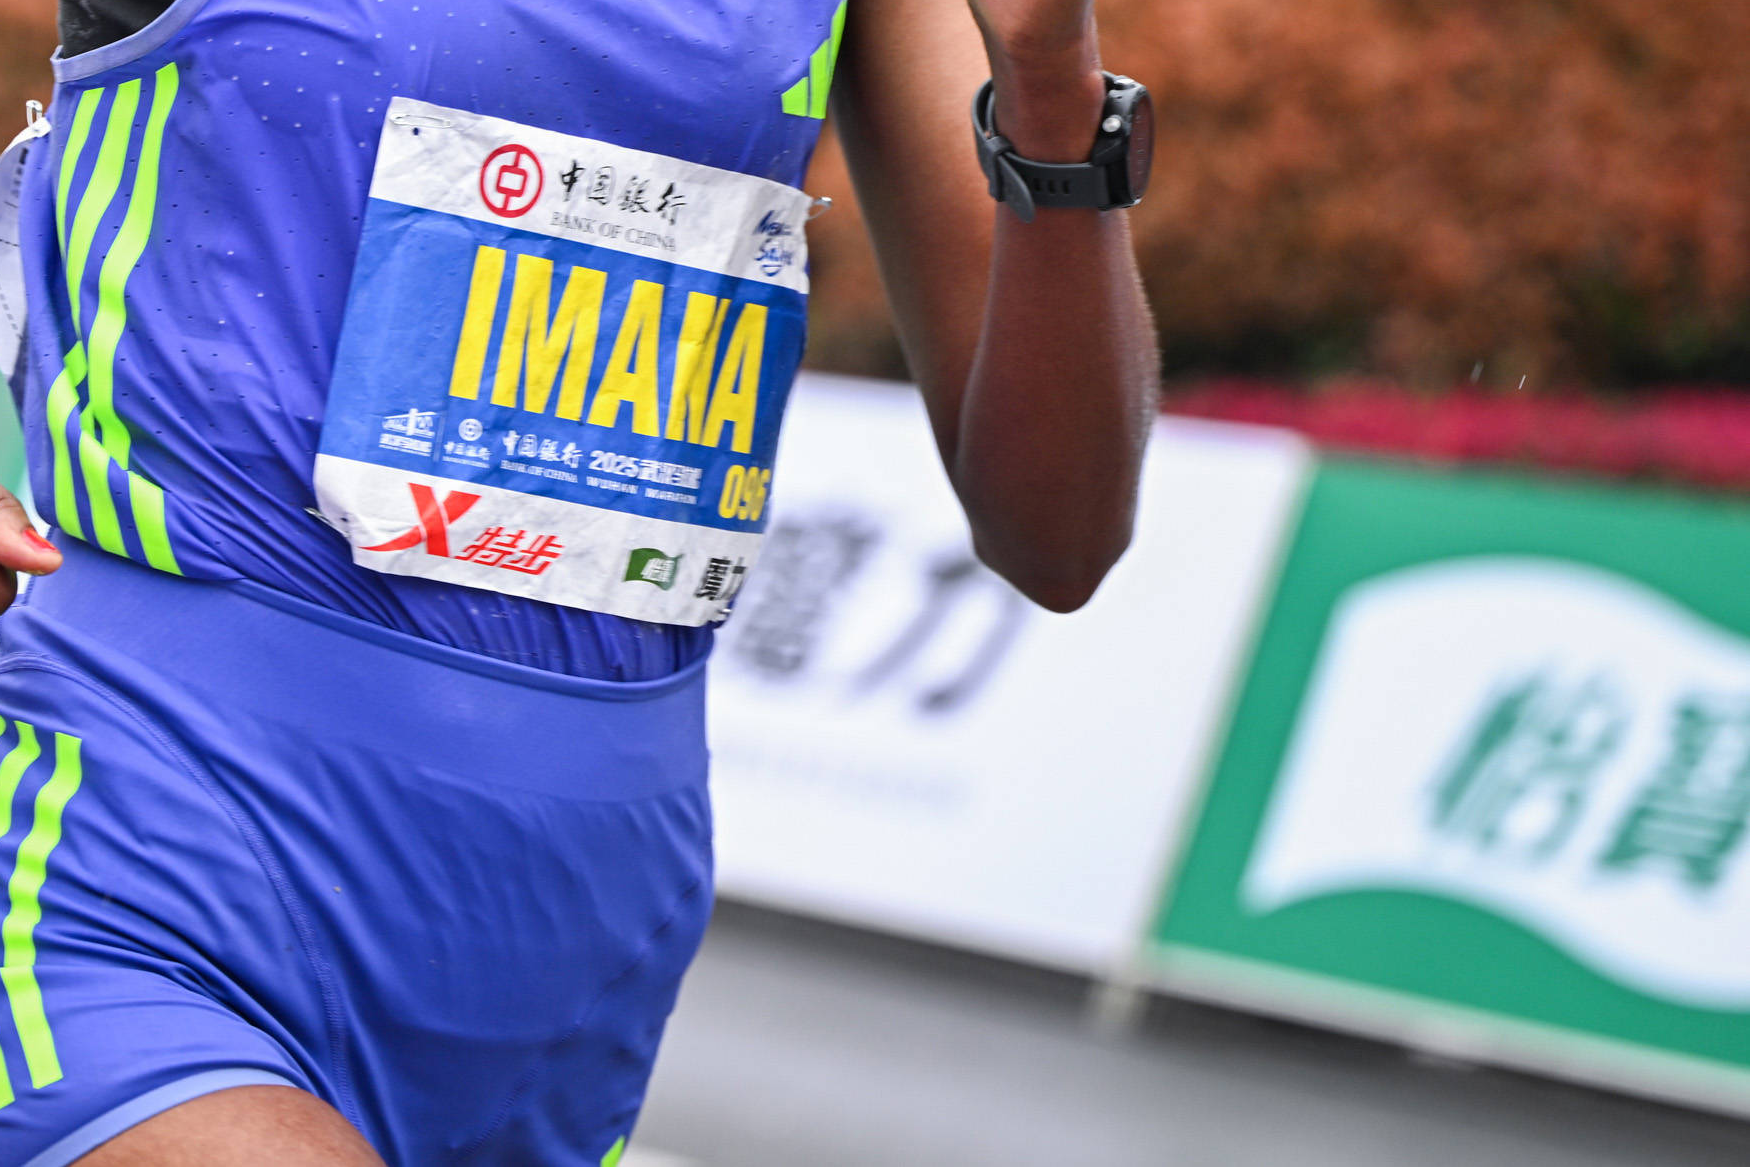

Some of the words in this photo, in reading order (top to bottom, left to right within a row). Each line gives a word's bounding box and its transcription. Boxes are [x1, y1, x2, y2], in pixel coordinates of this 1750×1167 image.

[550, 211, 596, 234] BANK
[602, 221, 622, 240] OF
[624, 227, 677, 252] CHINA
[448, 244, 769, 454] IMANA
[454, 525, 566, 576] 特步
